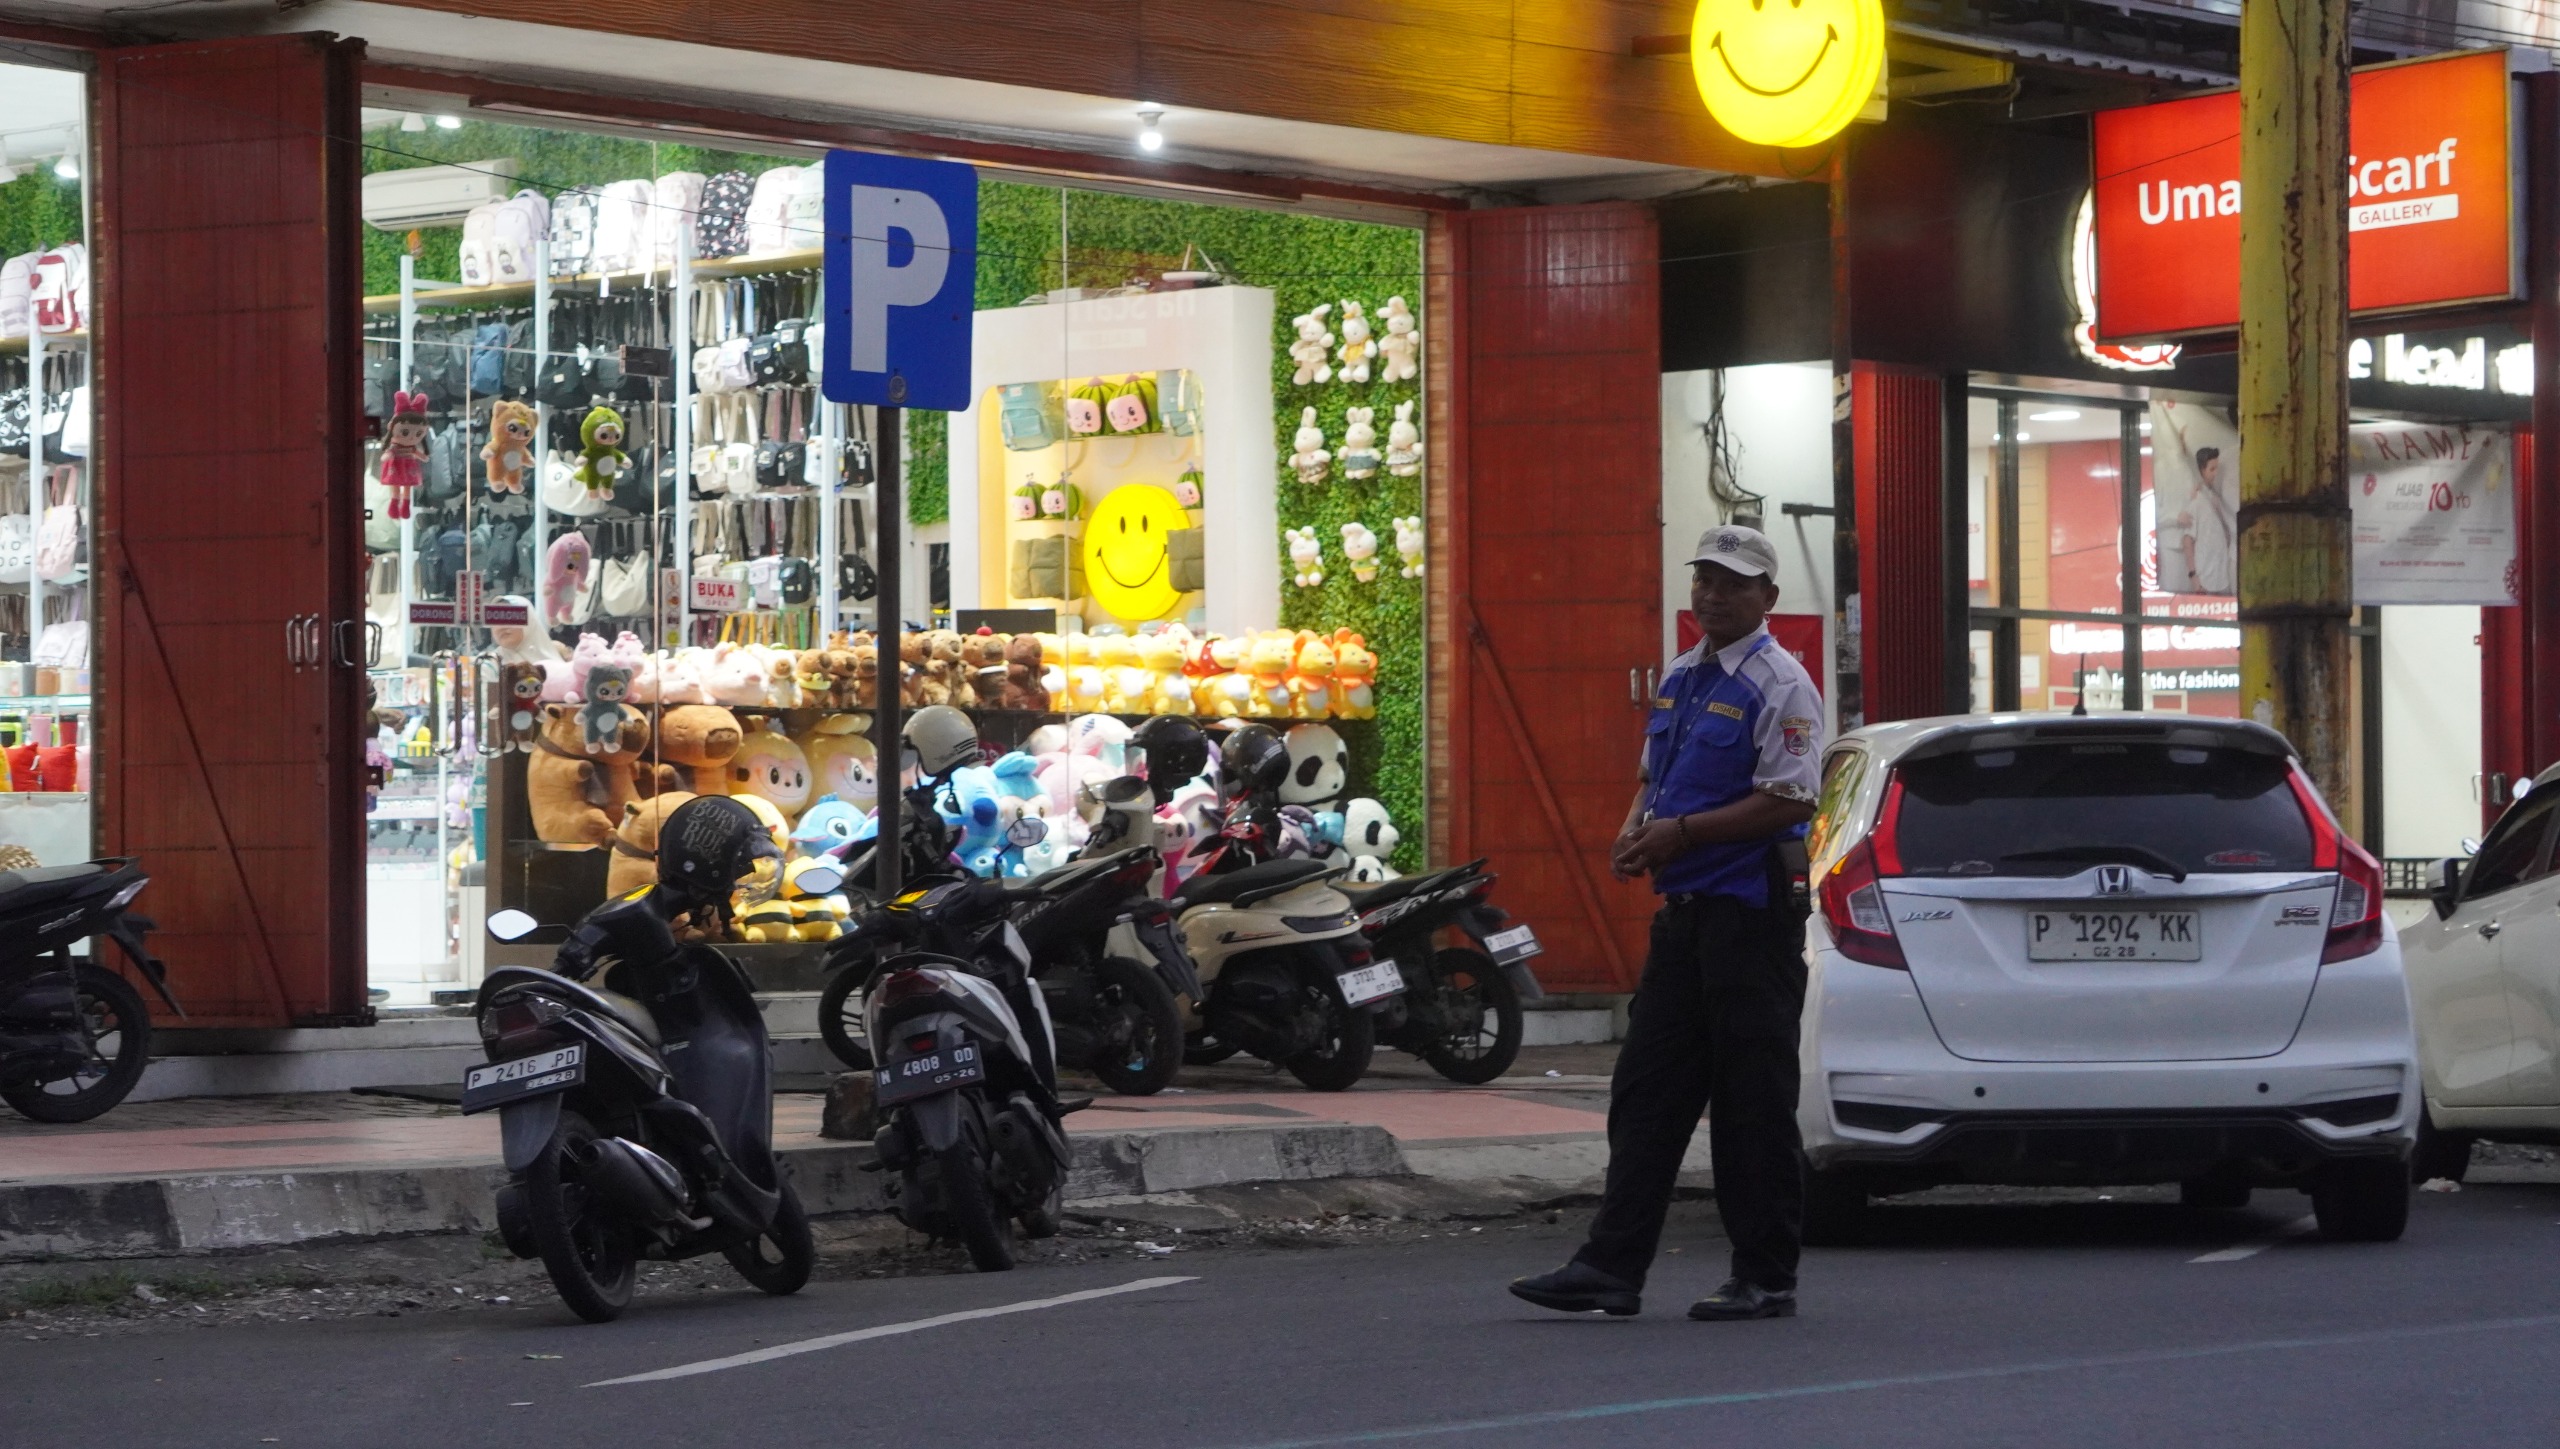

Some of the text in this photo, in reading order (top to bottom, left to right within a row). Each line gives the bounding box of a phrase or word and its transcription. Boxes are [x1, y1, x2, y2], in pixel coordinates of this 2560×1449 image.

[2138, 180, 2241, 225] Uma
[2358, 202, 2434, 225] GALLERY
[851, 184, 950, 373] P
[2384, 333, 2485, 390] lead
[2428, 481, 2453, 512] 10
[697, 582, 735, 598] BUKA
[411, 608, 454, 619] DORONG
[486, 610, 527, 620] DORONG
[2150, 671, 2177, 689] the
[2179, 670, 2240, 689] fashion
[1712, 703, 1741, 718] DISHUB
[690, 799, 741, 836] BORN
[1899, 910, 1954, 922] JAZZ
[2282, 906, 2320, 918] RS
[2034, 914, 2193, 942] P 1294 KK
[472, 1073, 482, 1088] P
[496, 1059, 536, 1082] 2416
[880, 1069, 891, 1085] N
[902, 1055, 940, 1076] 4808
